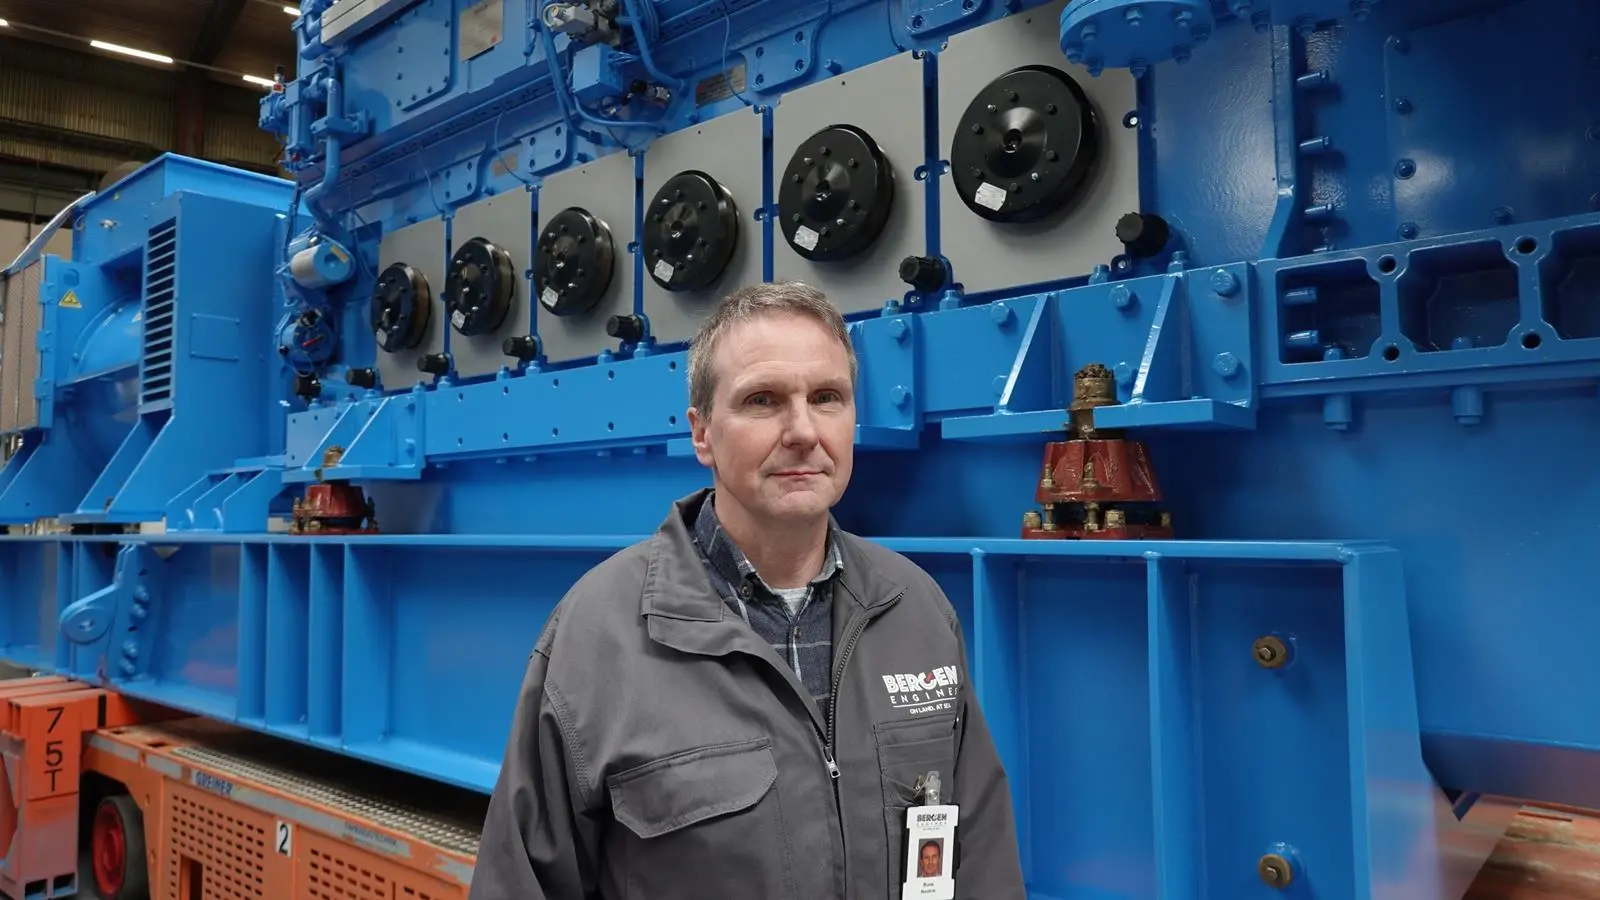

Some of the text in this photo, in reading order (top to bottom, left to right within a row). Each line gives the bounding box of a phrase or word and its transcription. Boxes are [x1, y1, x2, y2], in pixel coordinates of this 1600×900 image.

[882, 665, 958, 693] BERGEN
[917, 813, 947, 822] BERGEN
[279, 823, 289, 856] 2
